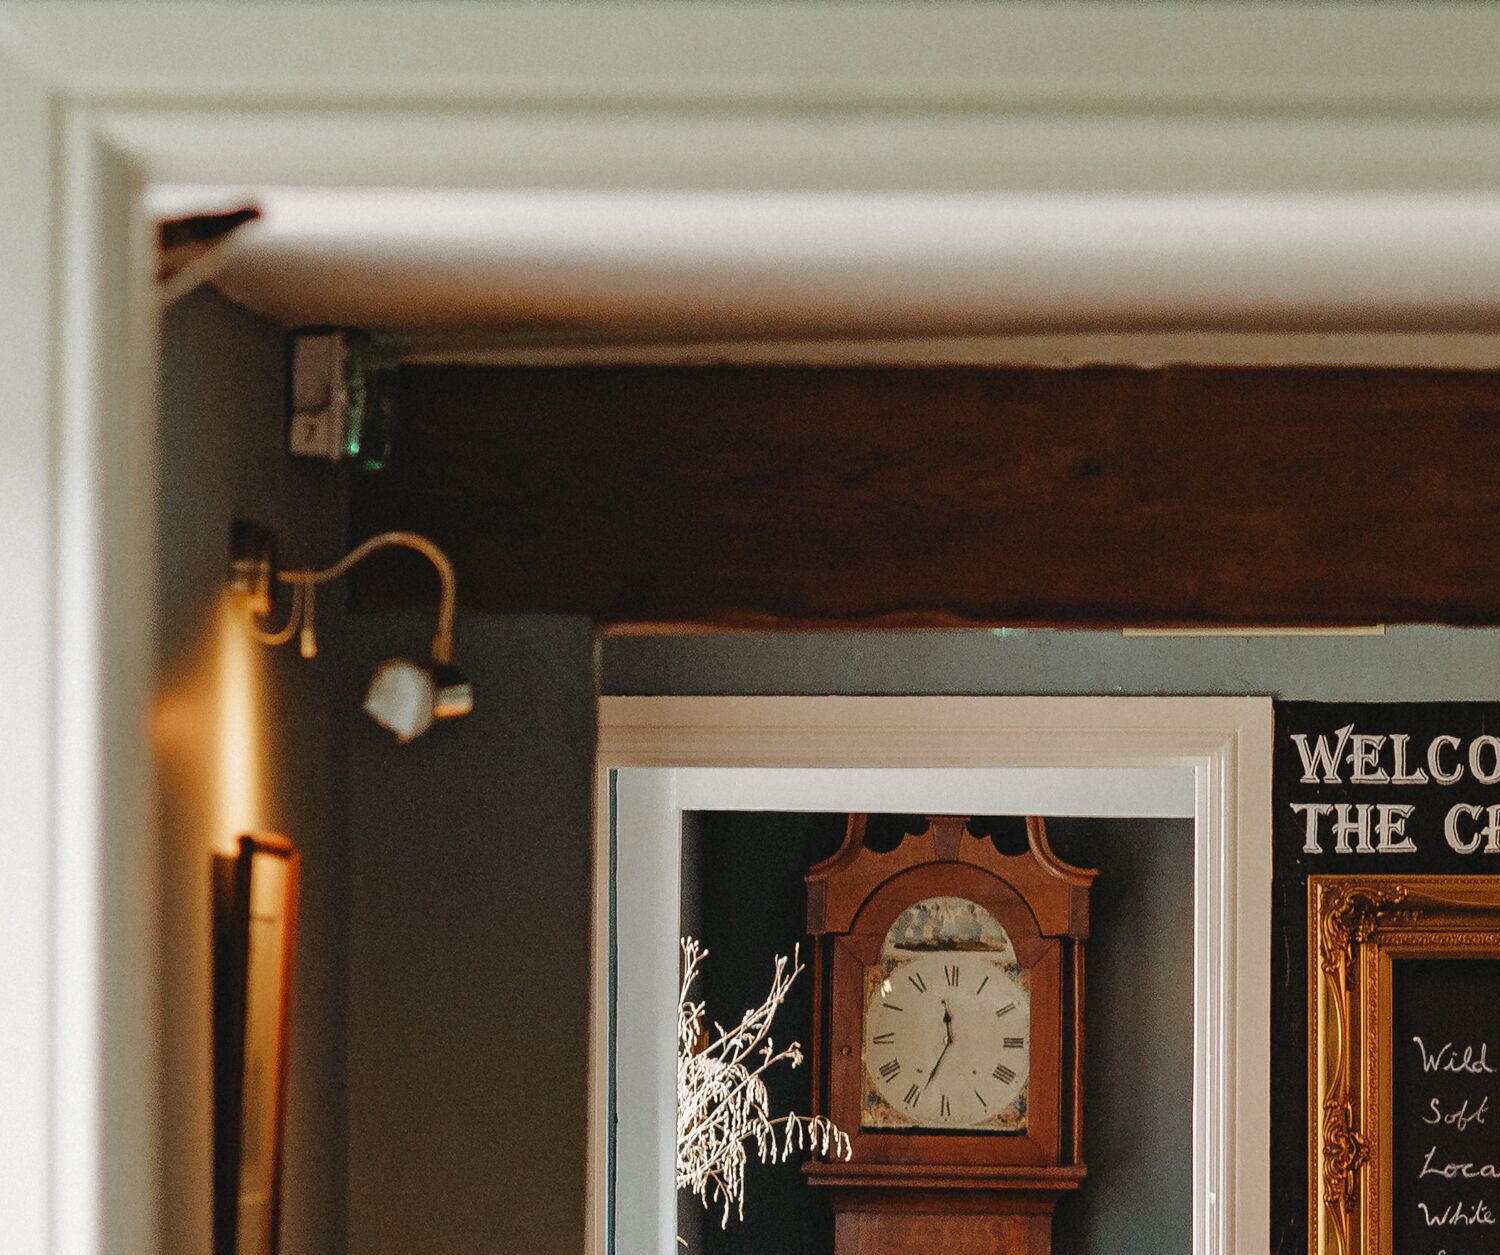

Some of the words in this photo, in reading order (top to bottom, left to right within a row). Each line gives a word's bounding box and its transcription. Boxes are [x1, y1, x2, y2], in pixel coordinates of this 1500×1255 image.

[1290, 803, 1418, 854] THE
[1412, 1036, 1494, 1074] Wild
[1422, 1096, 1488, 1132] Soft
[1417, 1200, 1496, 1227] White
